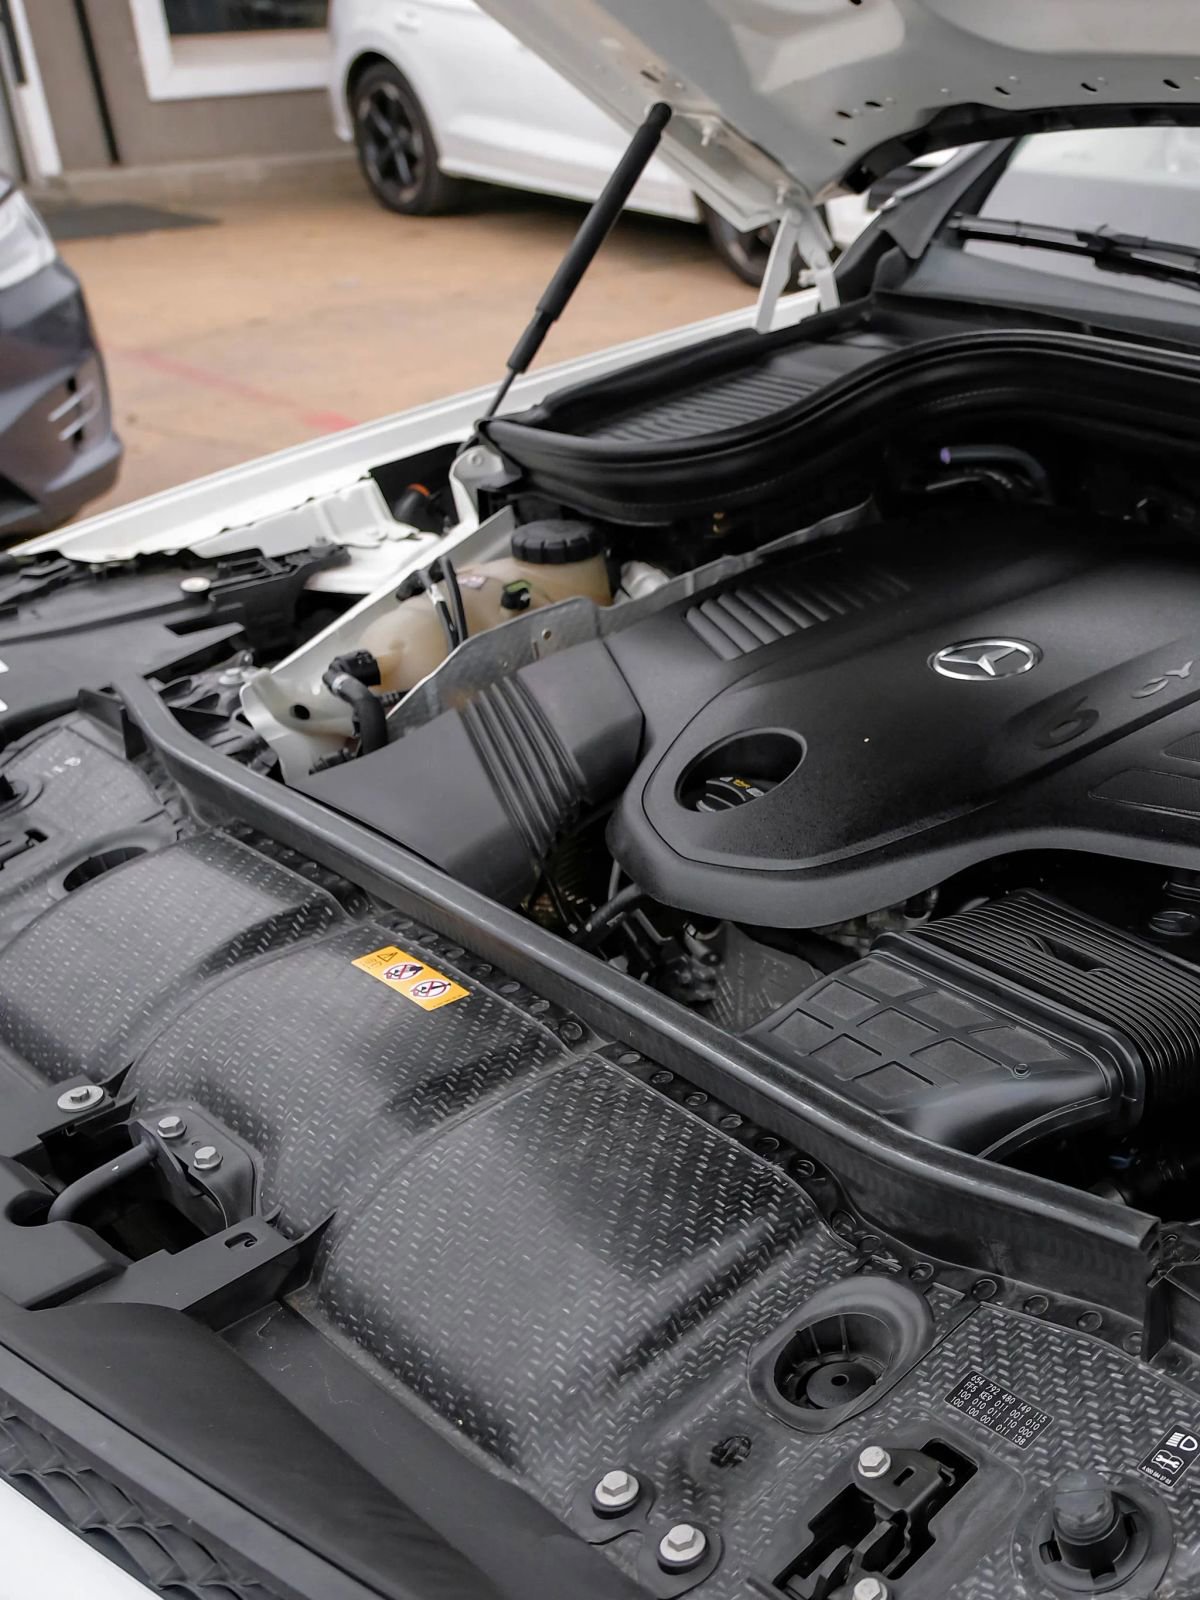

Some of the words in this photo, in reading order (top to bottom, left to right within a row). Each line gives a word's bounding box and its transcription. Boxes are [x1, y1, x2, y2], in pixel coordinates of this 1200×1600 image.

[1034, 696, 1100, 750] 6
[950, 1396, 964, 1408] 100
[965, 1406, 979, 1417] 100
[980, 1414, 994, 1426] 001
[995, 1424, 1010, 1436] 011
[1012, 1434, 1027, 1446] 138
[957, 1389, 972, 1400] 100
[971, 1398, 987, 1410] 010
[987, 1407, 1002, 1419] 011
[1003, 1417, 1018, 1428] 110
[1018, 1426, 1034, 1438] 000
[963, 1381, 979, 1393] FF5
[978, 1390, 993, 1402] KE9
[994, 1400, 1009, 1412] 011
[1009, 1409, 1025, 1421] 001
[1025, 1419, 1040, 1431] 010
[970, 1375, 986, 1386] 654
[985, 1383, 1001, 1396] 792
[1001, 1393, 1016, 1405] 480
[1017, 1402, 1032, 1414] 149
[1033, 1411, 1048, 1423] 115
